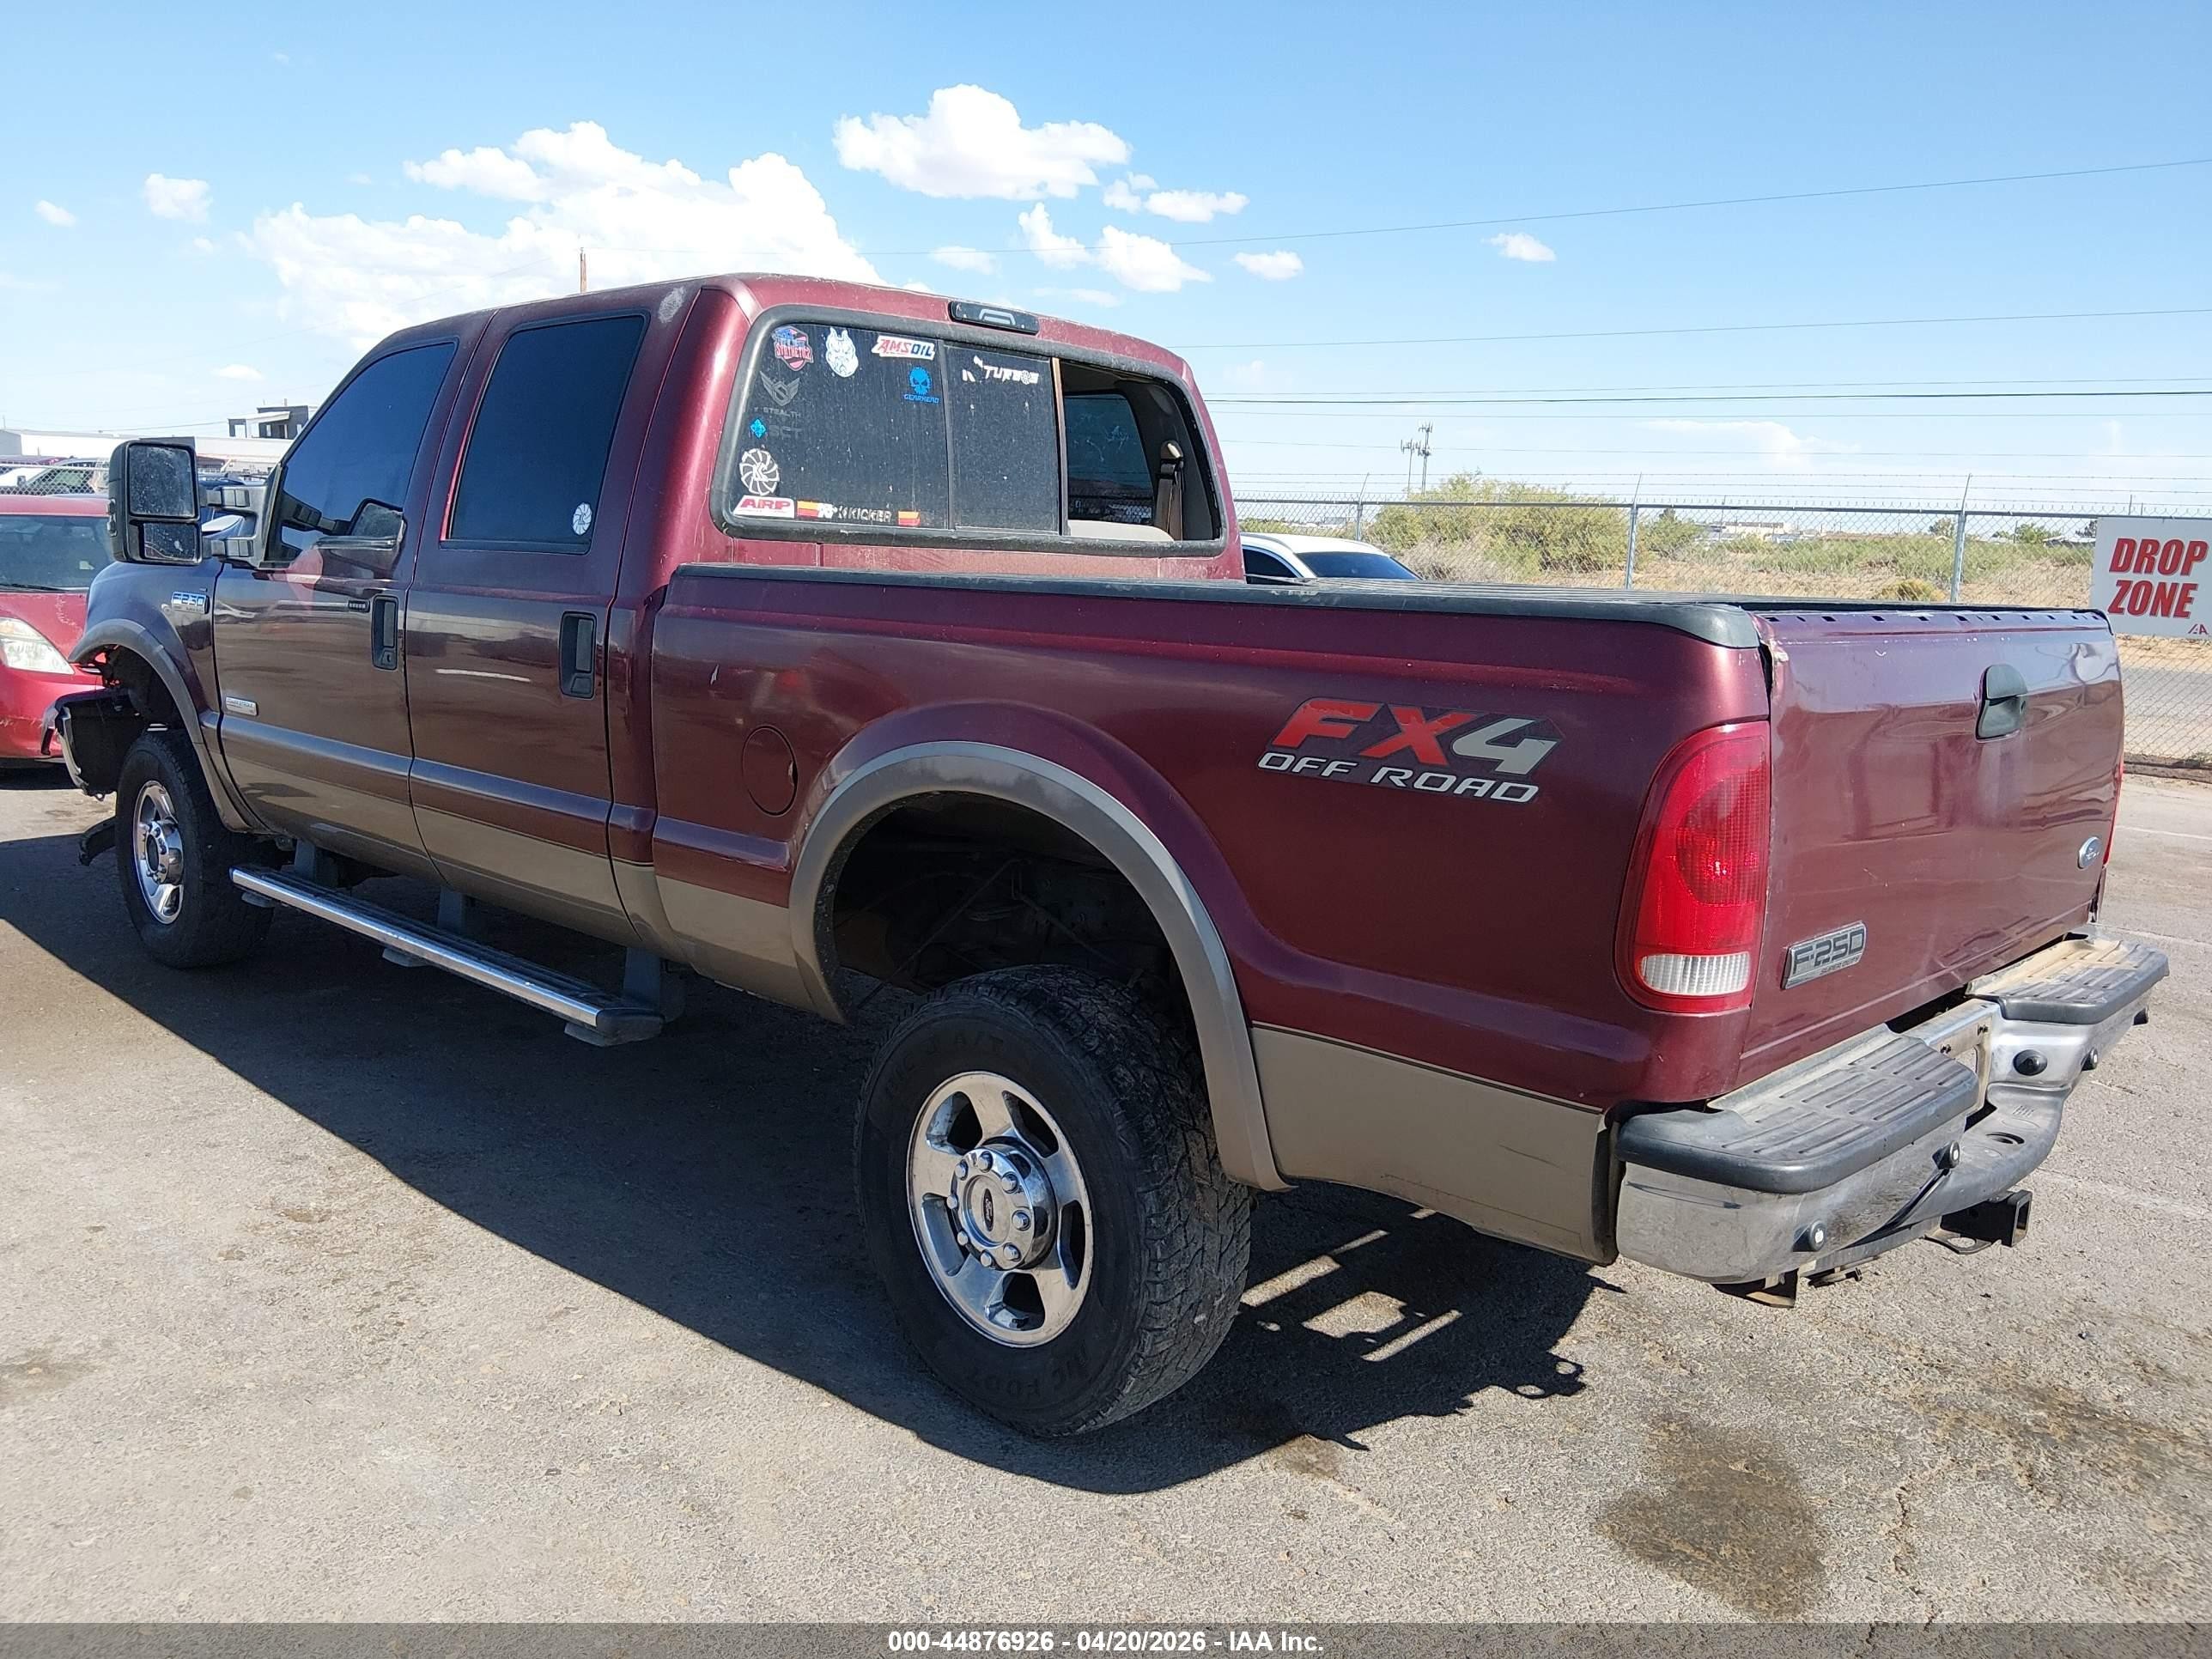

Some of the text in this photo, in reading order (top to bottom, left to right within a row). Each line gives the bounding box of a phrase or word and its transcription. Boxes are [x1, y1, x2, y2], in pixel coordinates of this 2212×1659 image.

[878, 339, 933, 356] AMSOIL
[903, 393, 939, 404] GEARHEAD
[740, 498, 791, 509] ARP
[848, 507, 892, 523] KICKER
[2109, 538, 2209, 576] DROP
[2107, 579, 2198, 619] ZONE
[1272, 697, 1559, 775] FX4
[1257, 752, 1540, 804] OFF ROAD
